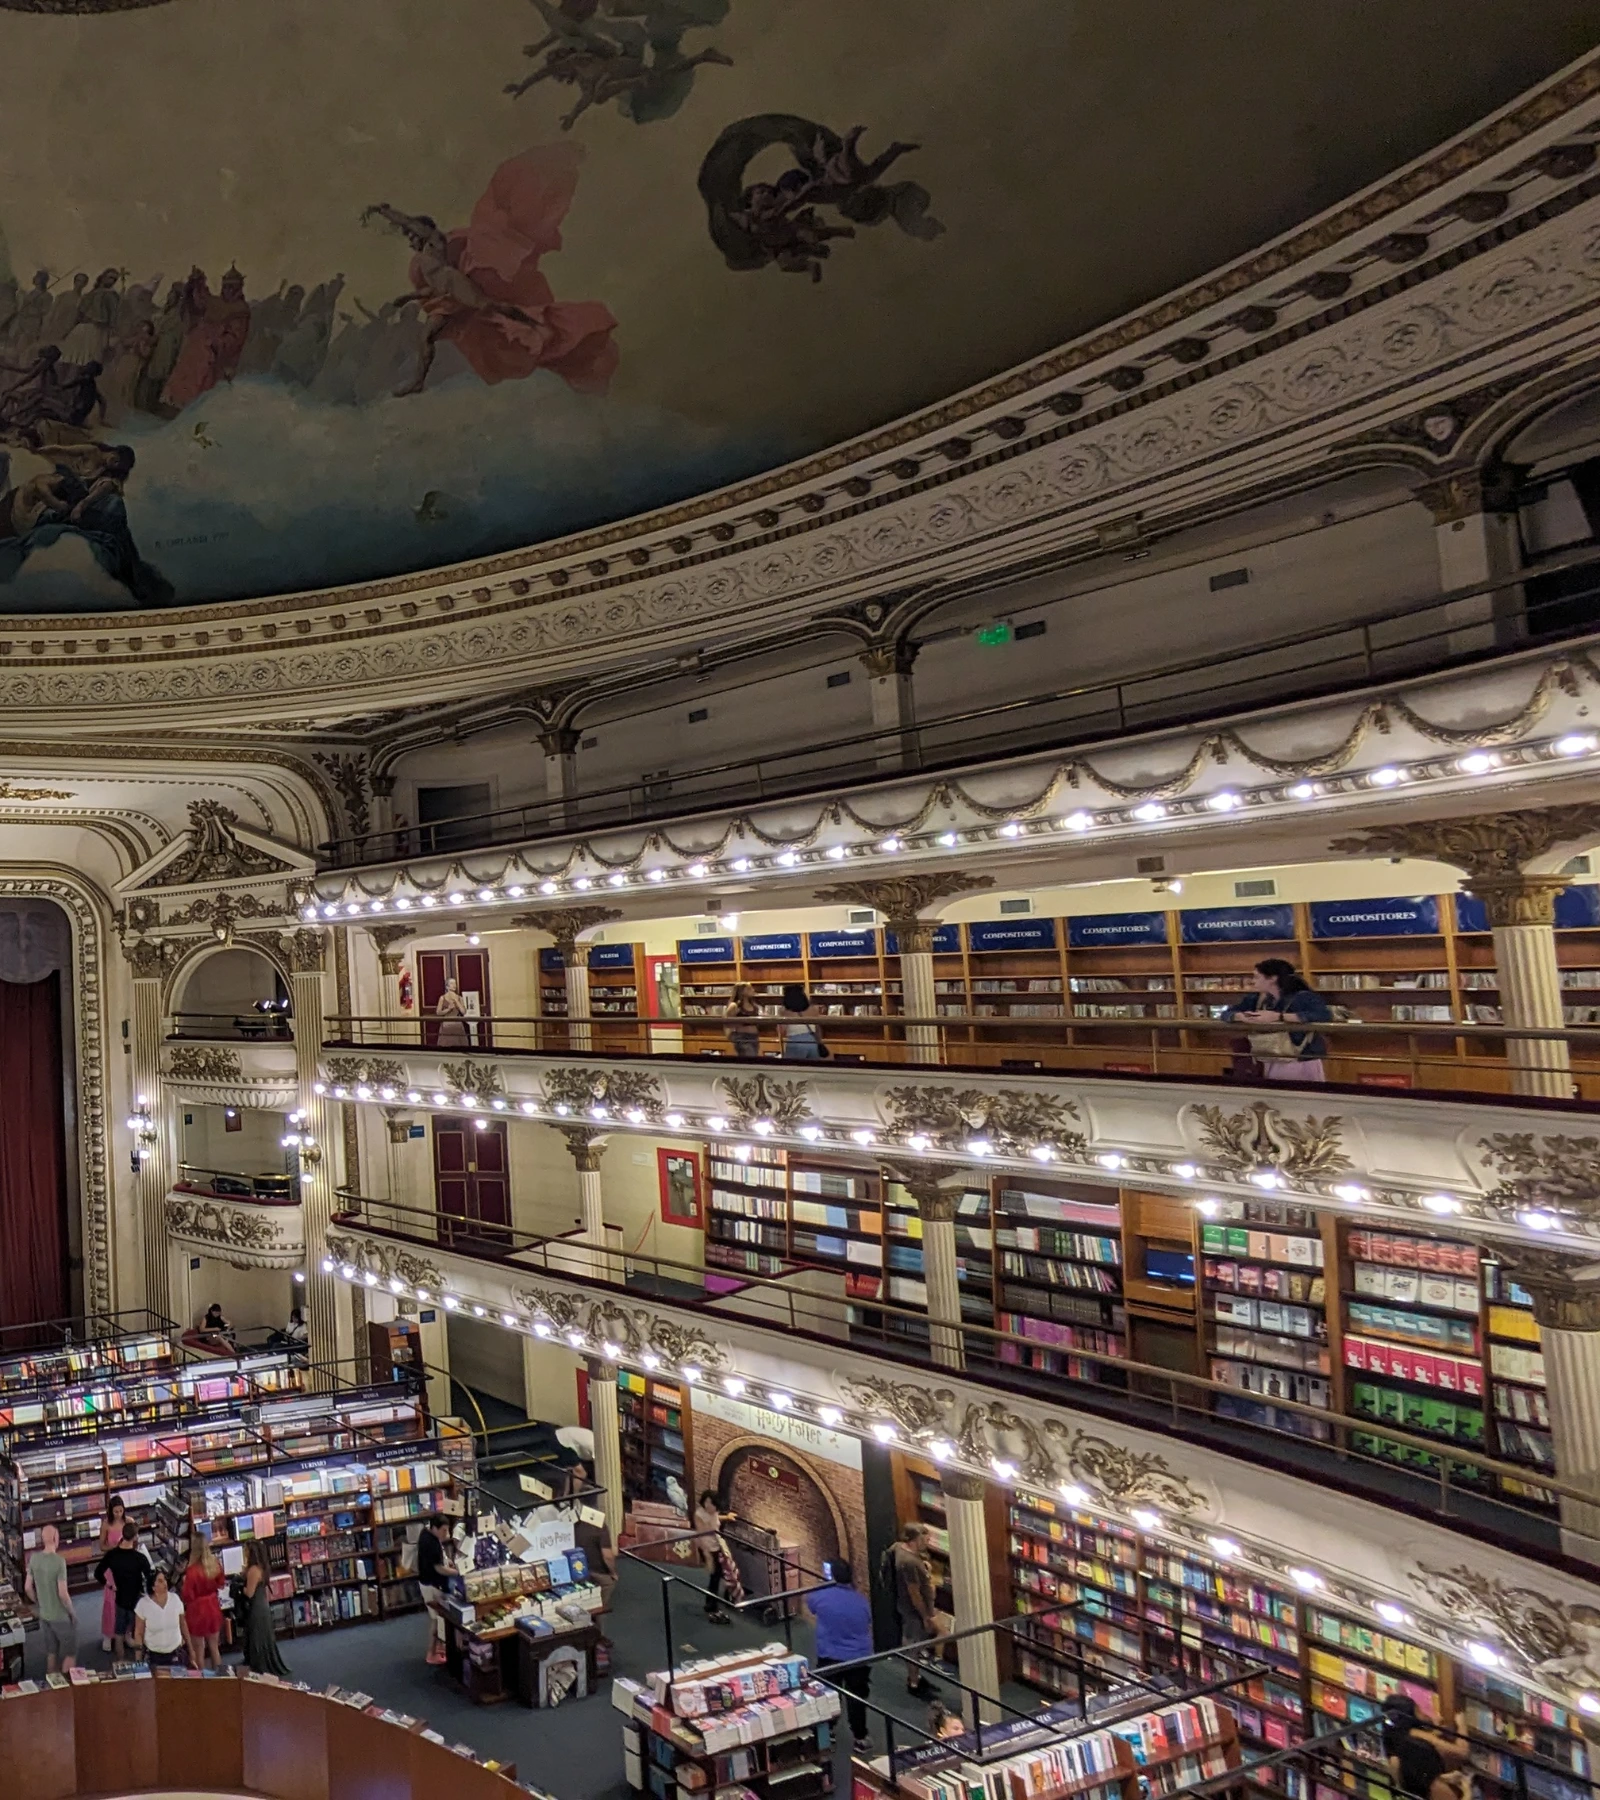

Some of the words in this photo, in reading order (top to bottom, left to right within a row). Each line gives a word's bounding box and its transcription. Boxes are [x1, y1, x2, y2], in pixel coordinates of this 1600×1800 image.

[1329, 910, 1417, 924] COMPOSITORES
[1197, 918, 1276, 930] COMPOSITORES
[1082, 925, 1150, 935] COMPOSITORES
[982, 931, 1042, 940] COMPOSITORES
[749, 943, 792, 952] COMPOSITORES
[818, 939, 865, 948] COMPOSITORES
[756, 1408, 787, 1434] Harry
[787, 1417, 822, 1445] Potter
[300, 1460, 327, 1470] TURISMO
